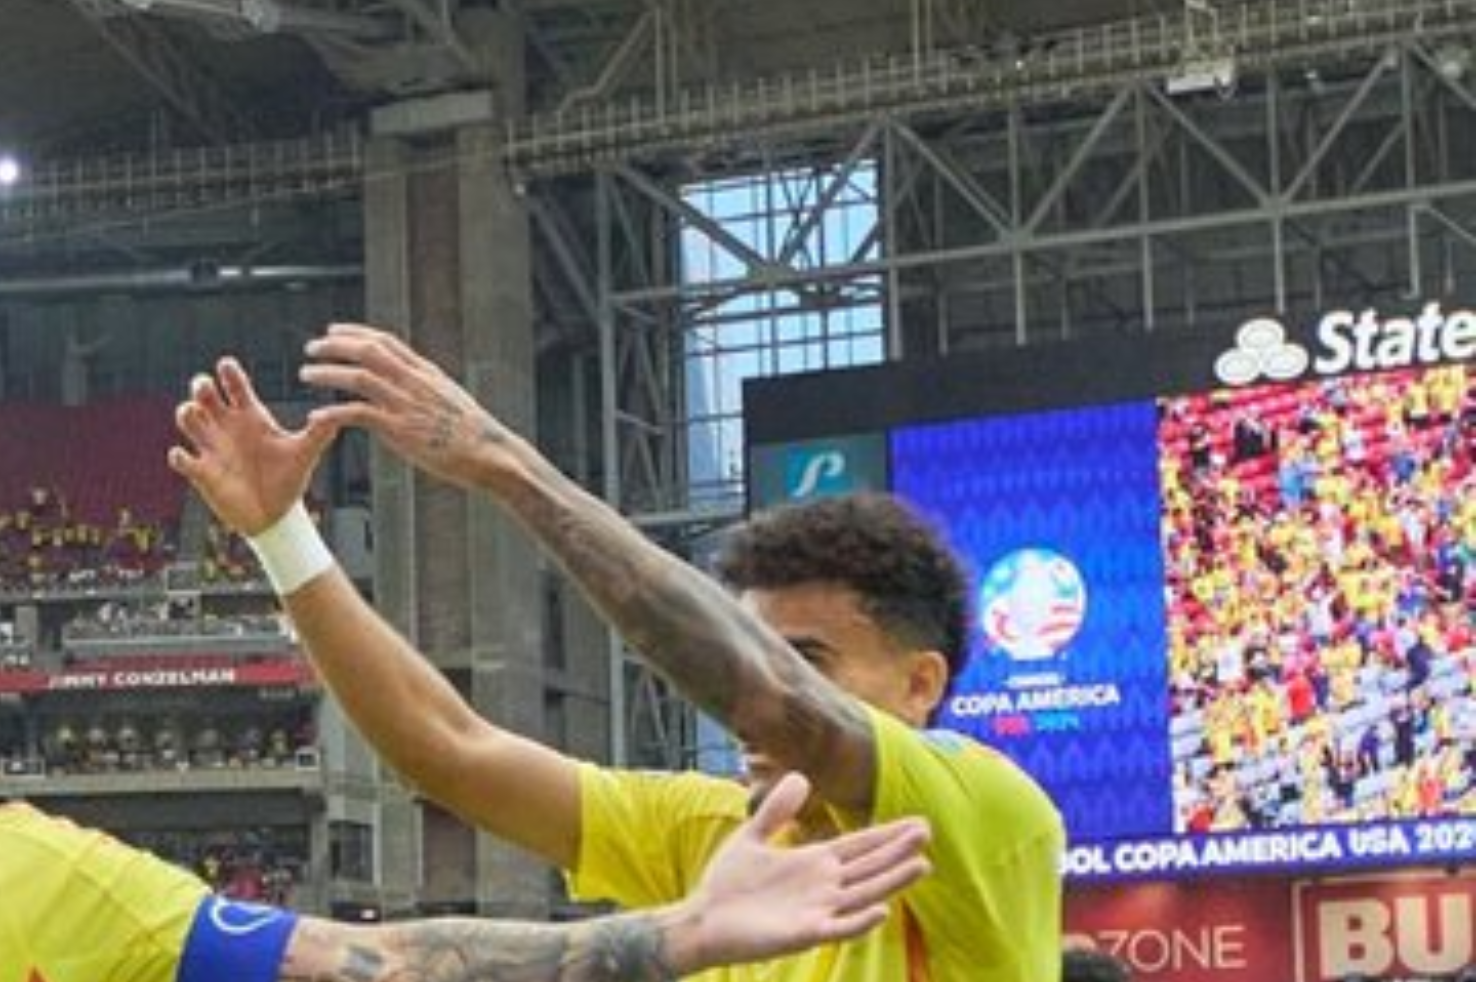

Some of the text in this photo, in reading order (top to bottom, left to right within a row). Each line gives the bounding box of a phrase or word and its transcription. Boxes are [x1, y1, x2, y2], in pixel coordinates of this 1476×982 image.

[1314, 302, 1476, 375] State
[951, 693, 1014, 717] COPA
[1114, 841, 1199, 873] COPA
[1198, 830, 1343, 868] AMERICA
[1347, 824, 1412, 855] USA
[1062, 924, 1248, 974] ZONE
